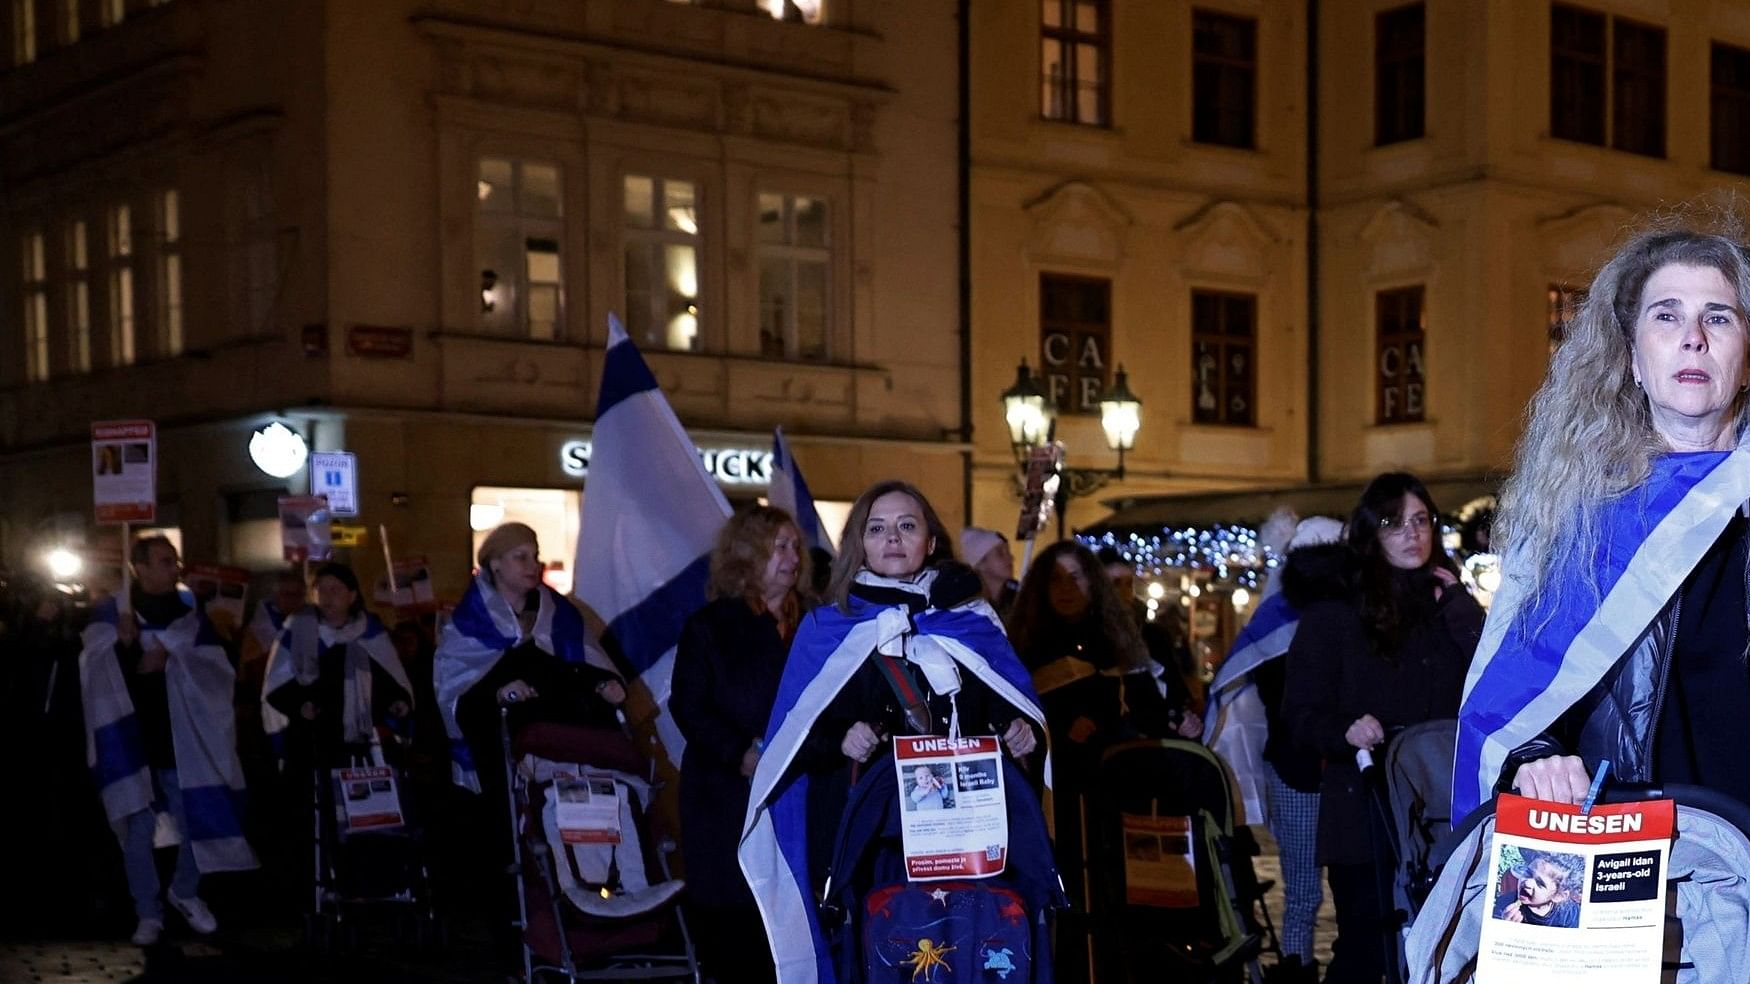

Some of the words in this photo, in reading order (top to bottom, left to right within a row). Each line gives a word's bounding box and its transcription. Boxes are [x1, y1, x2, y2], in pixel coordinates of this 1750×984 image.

[912, 738, 981, 752] UNESEN
[1528, 809, 1643, 834] UNESEN
[1597, 857, 1631, 869] Avigail
[1632, 857, 1654, 866] Idan
[1596, 868, 1651, 882] 3-years-old
[1595, 882, 1626, 892] Israeli
